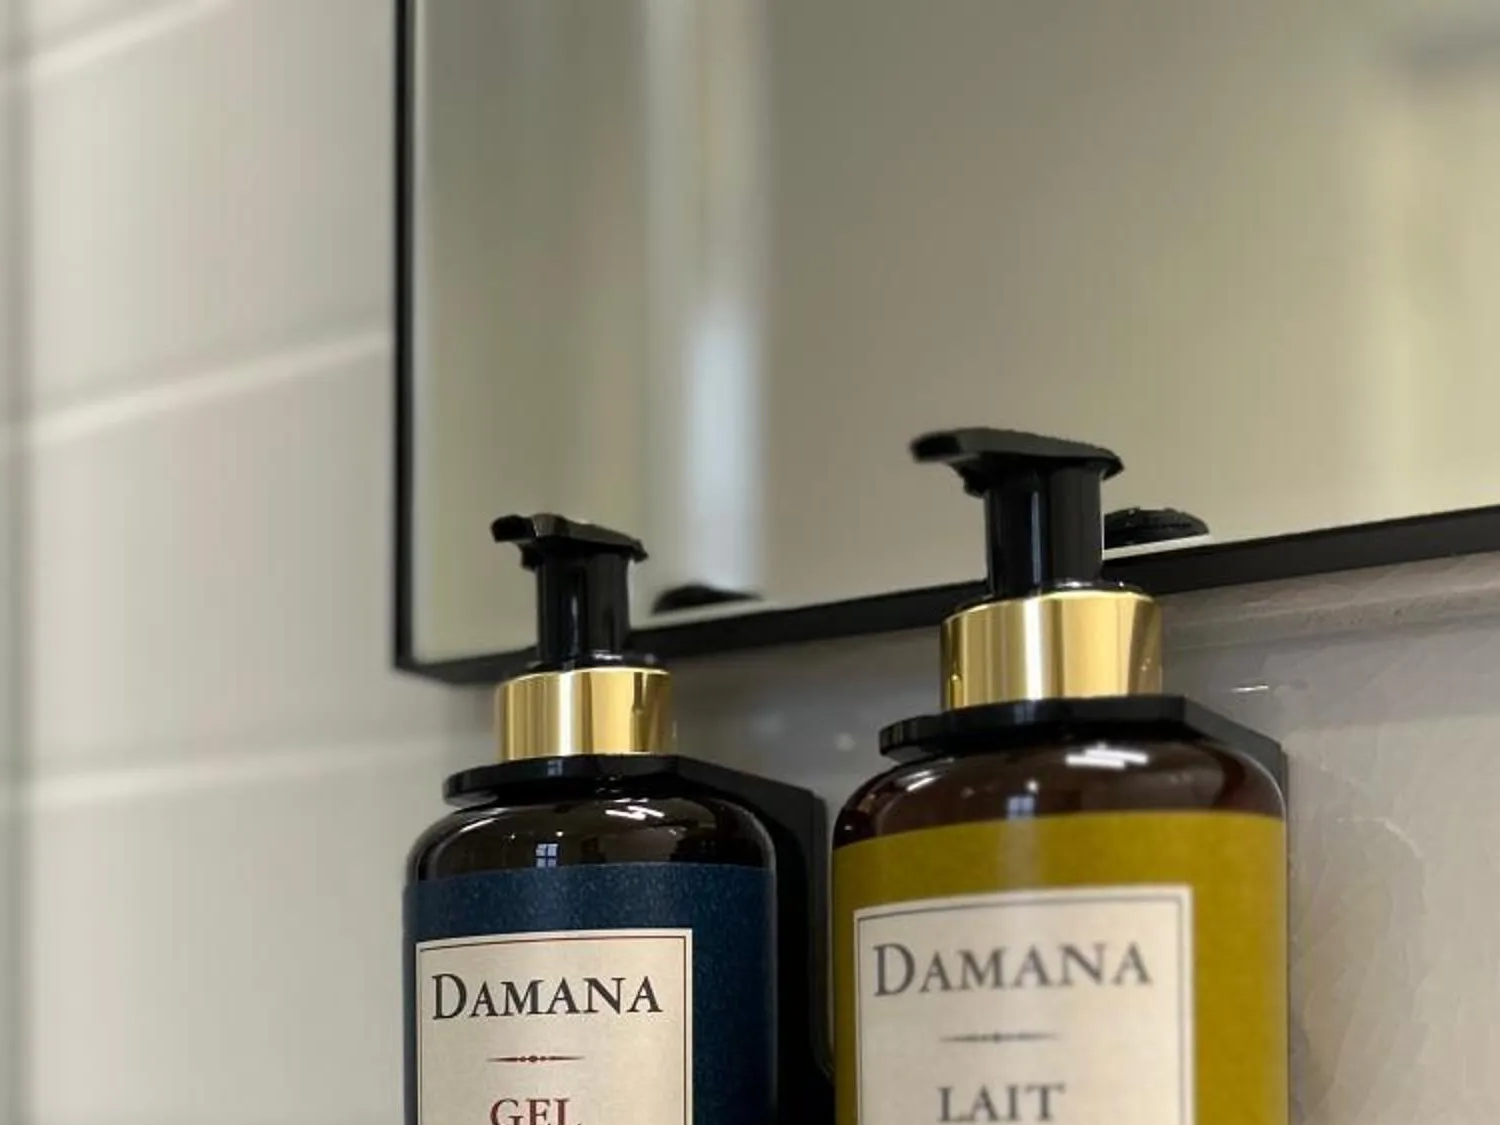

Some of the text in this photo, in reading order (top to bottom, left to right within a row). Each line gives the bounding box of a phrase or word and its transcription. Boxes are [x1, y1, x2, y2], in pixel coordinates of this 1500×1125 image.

[873, 942, 1153, 997] DAMANA
[432, 974, 663, 1020] DAMANA
[938, 1084, 1065, 1122] LAIT
